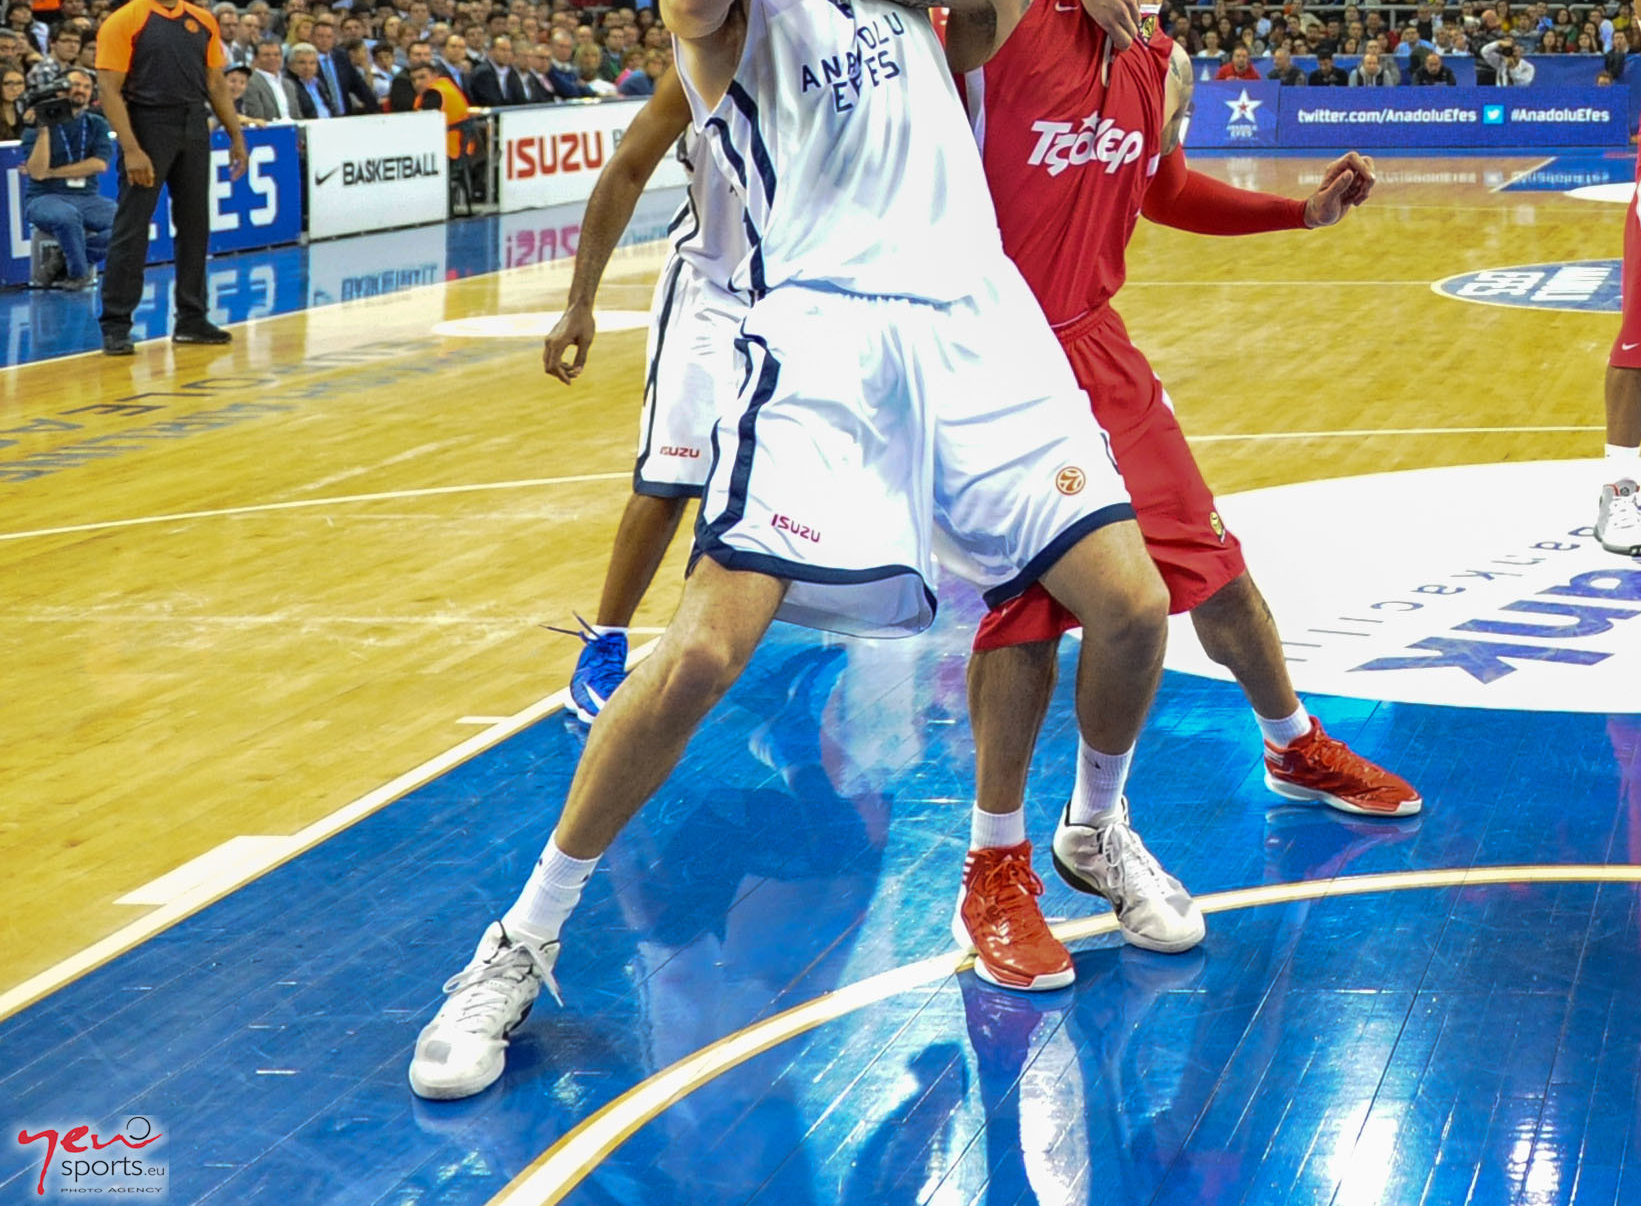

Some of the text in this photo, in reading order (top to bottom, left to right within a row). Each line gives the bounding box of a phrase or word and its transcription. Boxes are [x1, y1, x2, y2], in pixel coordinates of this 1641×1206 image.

[802, 11, 905, 93] ANAOLU
[1298, 108, 1611, 123] twitter.com/AnadoluEfes #AnadoluEfes
[342, 153, 439, 187] BASKETBALL
[506, 130, 604, 181] ISUZU
[771, 513, 821, 543] ISUZU
